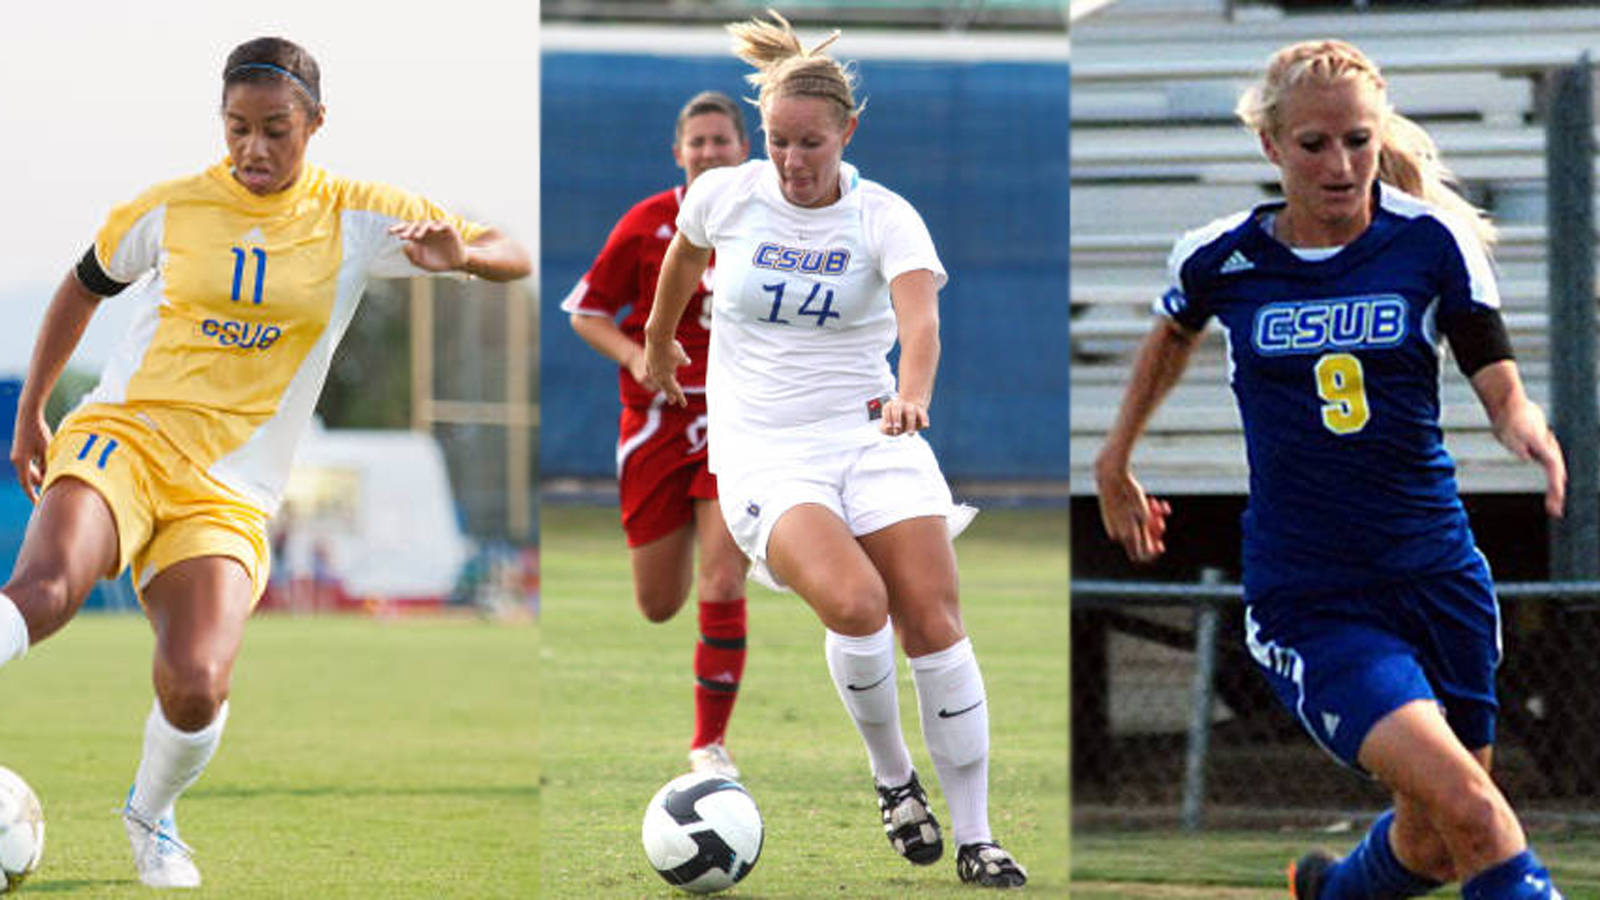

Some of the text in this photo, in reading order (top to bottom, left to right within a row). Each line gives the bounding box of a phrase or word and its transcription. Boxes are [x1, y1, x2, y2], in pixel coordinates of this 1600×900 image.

[231, 247, 267, 304] 11
[754, 243, 849, 274] CSUB
[757, 282, 840, 326] 14
[1256, 298, 1406, 352] CSUB
[1314, 353, 1371, 434] 9
[77, 434, 118, 469] 11
